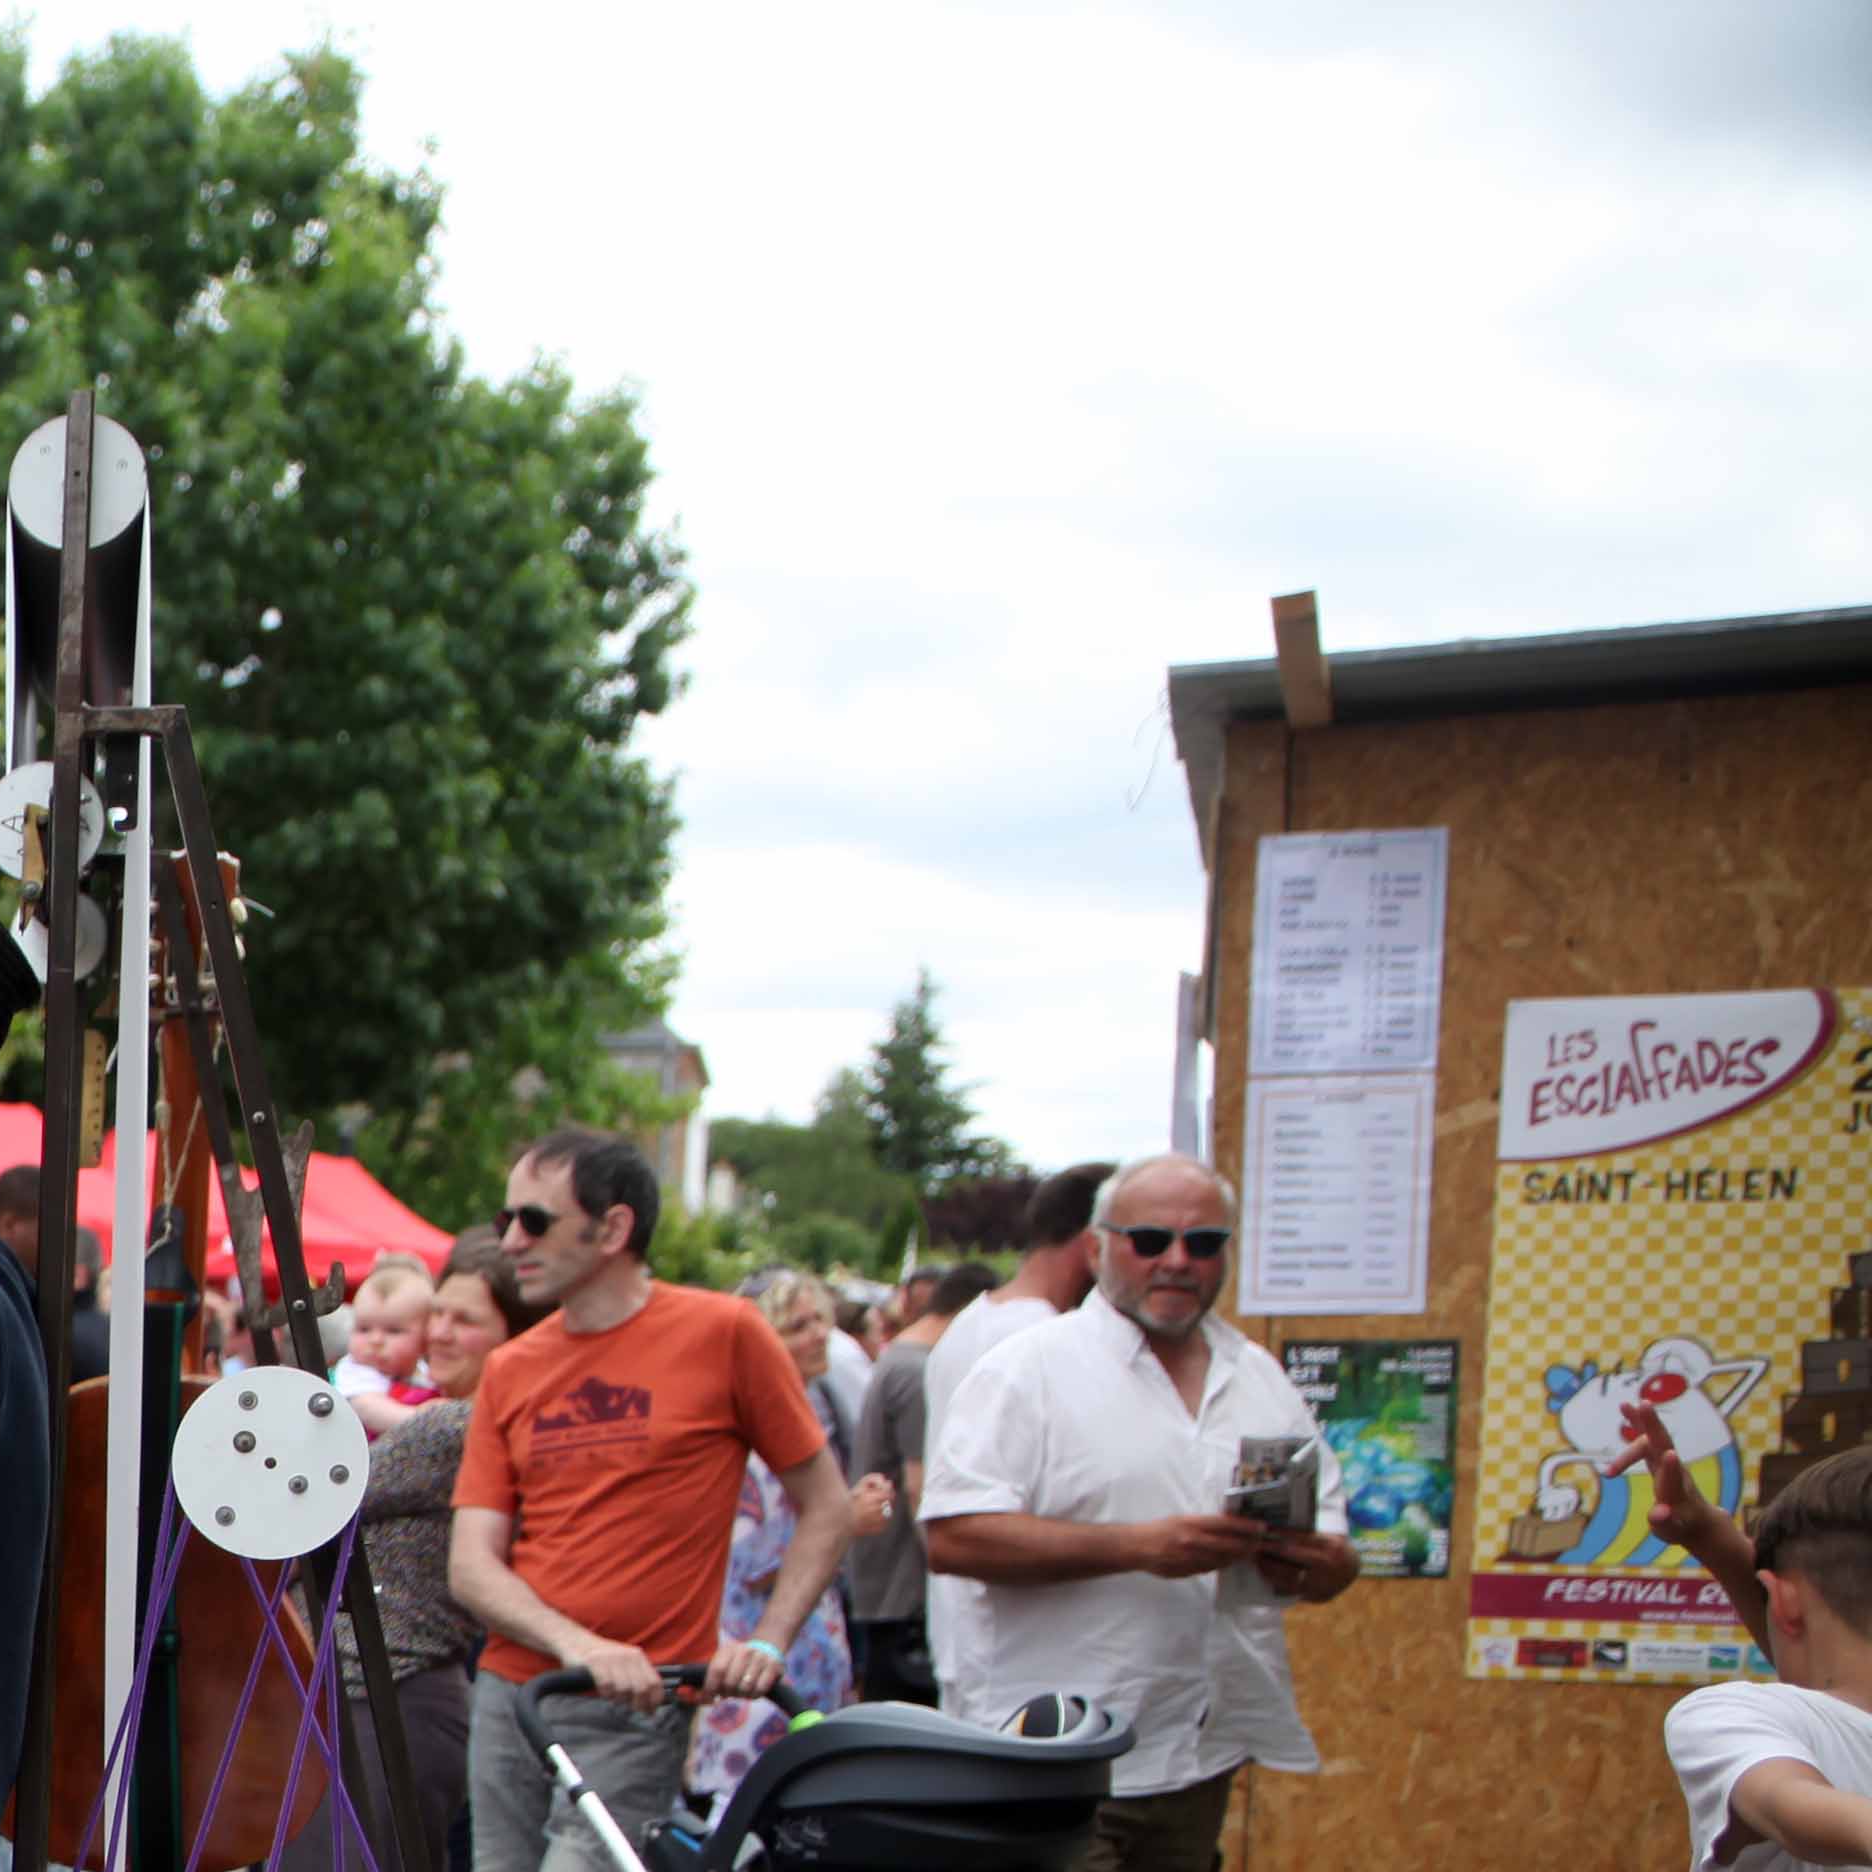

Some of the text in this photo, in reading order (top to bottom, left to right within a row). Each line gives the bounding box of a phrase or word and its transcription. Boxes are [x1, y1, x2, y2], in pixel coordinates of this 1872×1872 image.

[1546, 1029, 1598, 1068] LES
[1527, 1020, 1781, 1127] ESCLAFFADES
[1544, 1578, 1688, 1605] FESTIVAL
